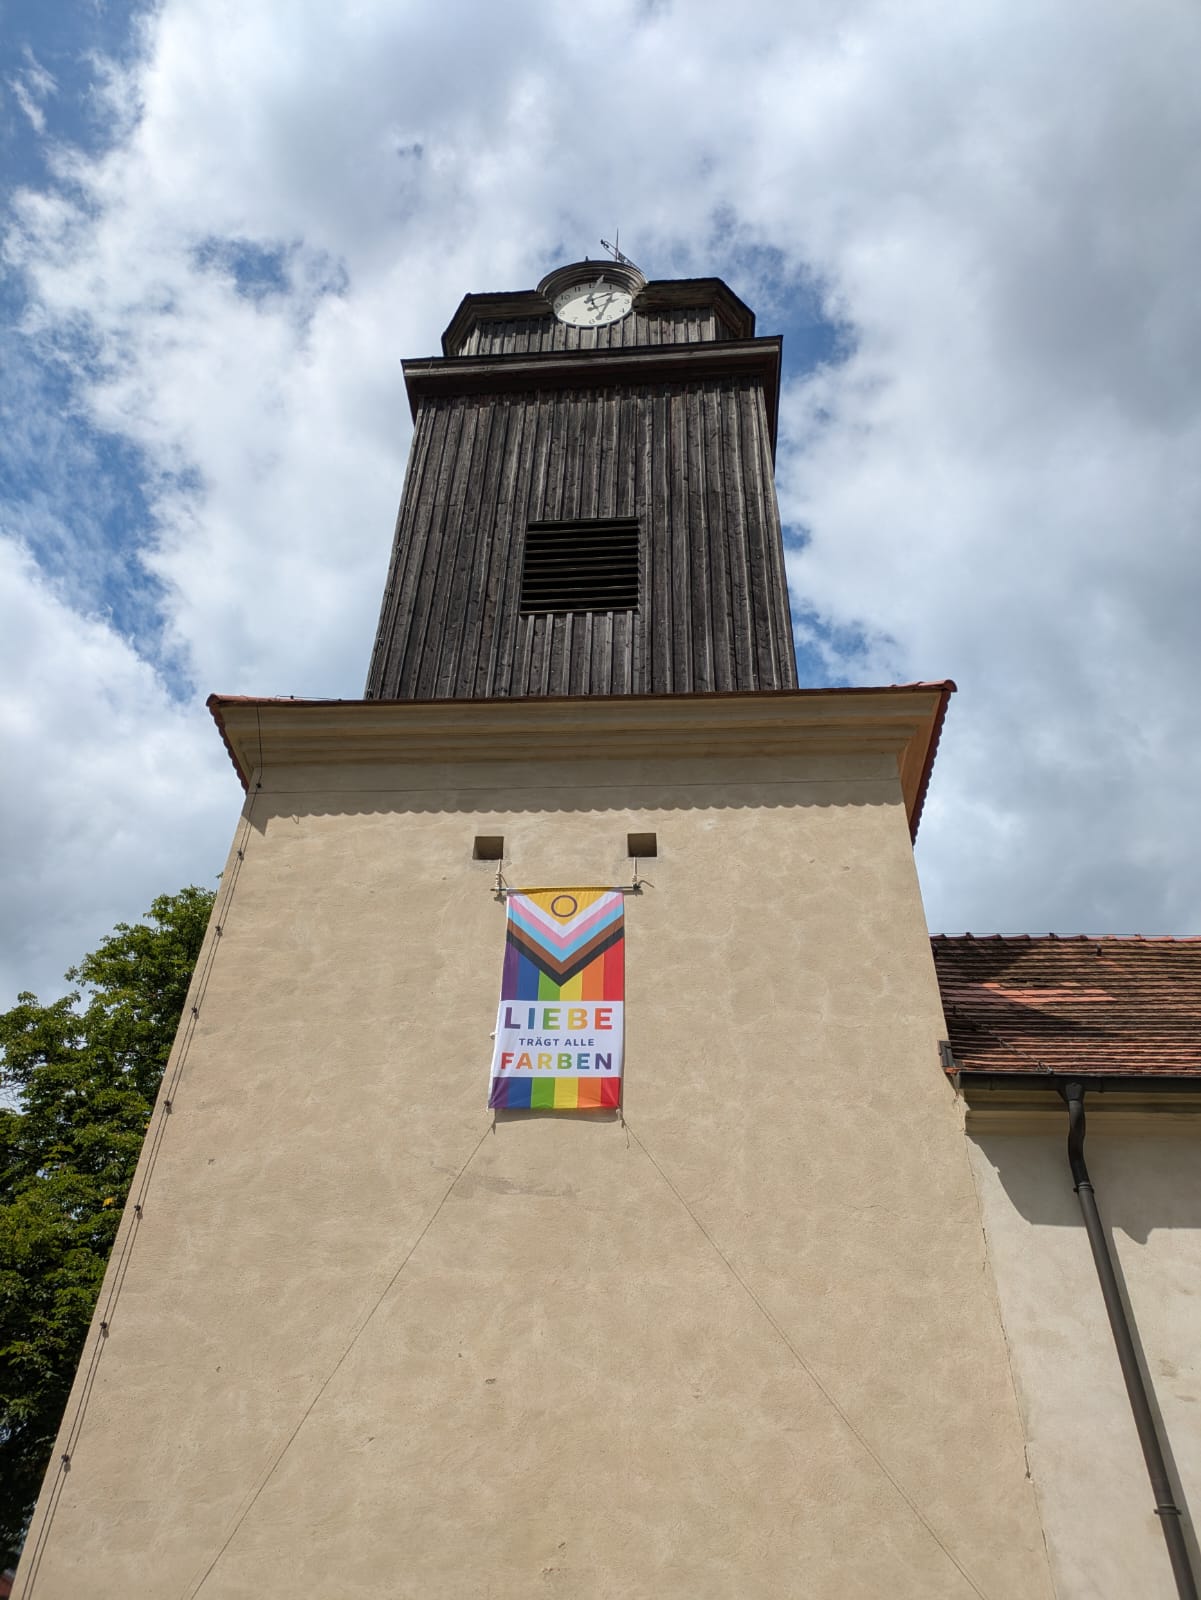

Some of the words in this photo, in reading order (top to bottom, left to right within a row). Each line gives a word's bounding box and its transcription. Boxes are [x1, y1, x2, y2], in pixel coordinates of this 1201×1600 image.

[504, 1007, 613, 1030] LIEBE
[519, 1036, 560, 1047] TRÄGT
[564, 1038, 595, 1047] ALLE
[500, 1052, 612, 1070] FARBEN
